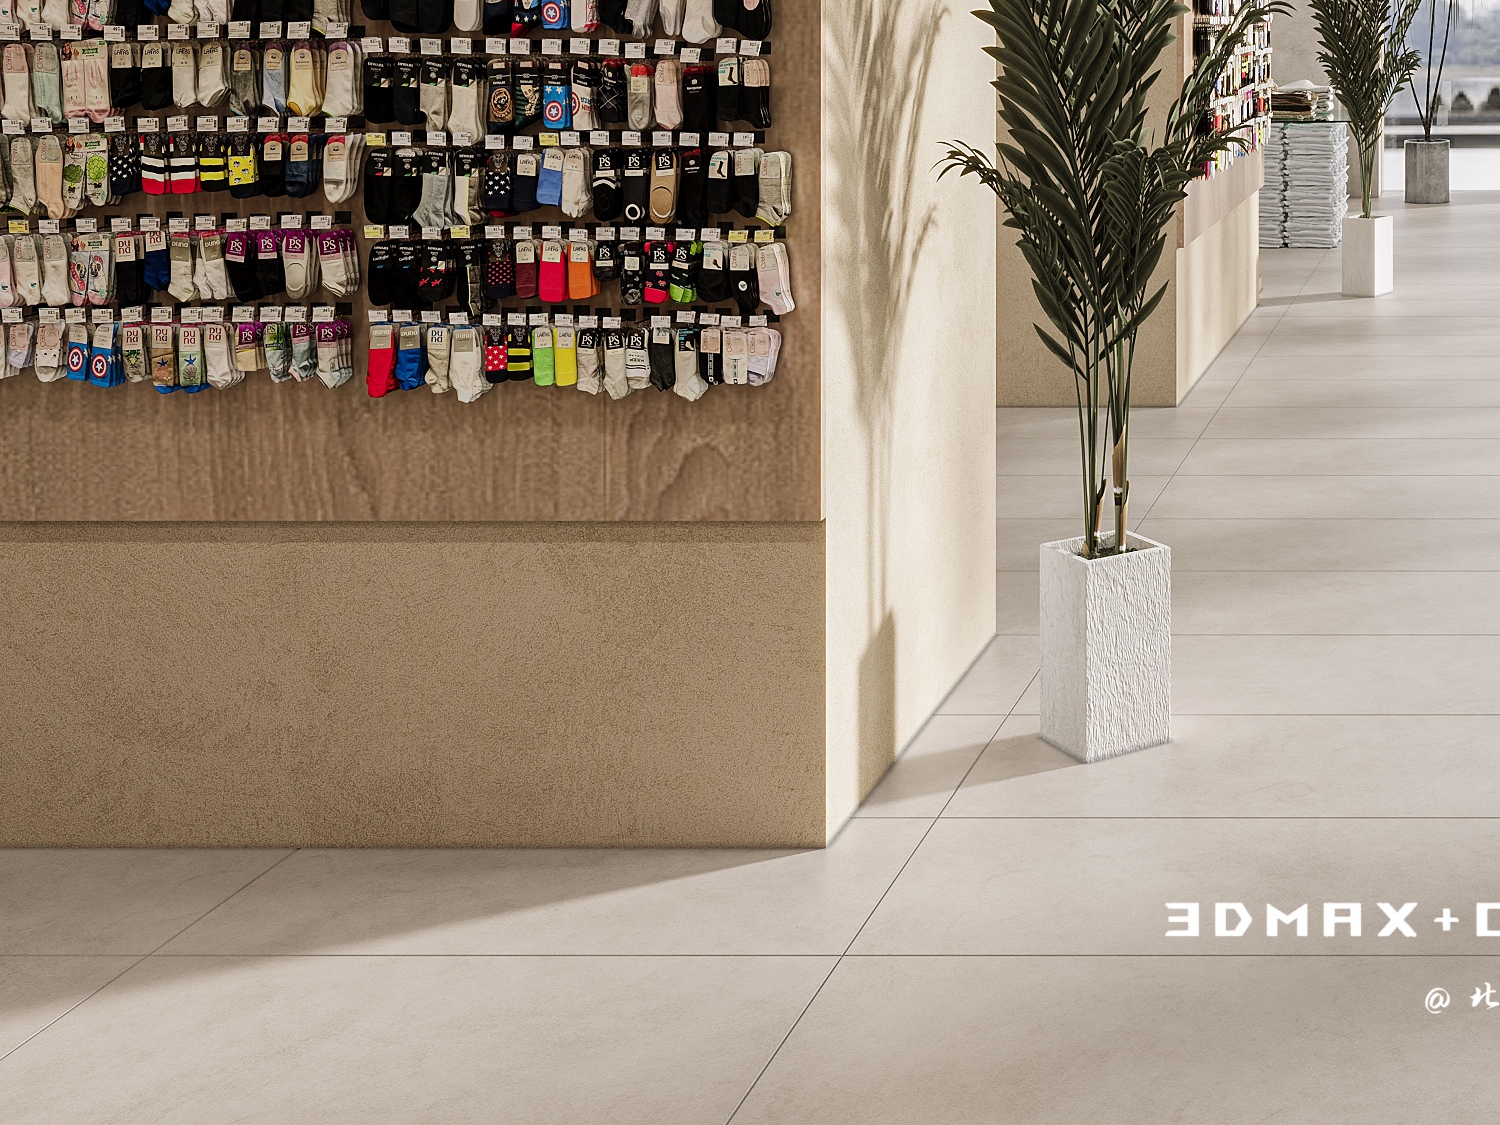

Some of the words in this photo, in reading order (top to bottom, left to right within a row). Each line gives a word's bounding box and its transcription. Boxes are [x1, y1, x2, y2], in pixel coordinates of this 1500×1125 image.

[599, 157, 610, 167] PS
[628, 157, 640, 167] PS
[658, 156, 670, 166] PS
[230, 241, 242, 252] PS
[261, 239, 273, 249] PS
[289, 239, 301, 250] PS
[323, 240, 336, 251] PS
[599, 248, 610, 258] PS
[654, 250, 665, 260] PS
[676, 250, 687, 260] PS
[267, 325, 276, 333] PS
[296, 325, 306, 334] PS
[321, 328, 333, 338] PS
[242, 332, 253, 341] PS
[582, 336, 592, 346] PS
[608, 336, 620, 347] PS
[630, 336, 642, 347] PS
